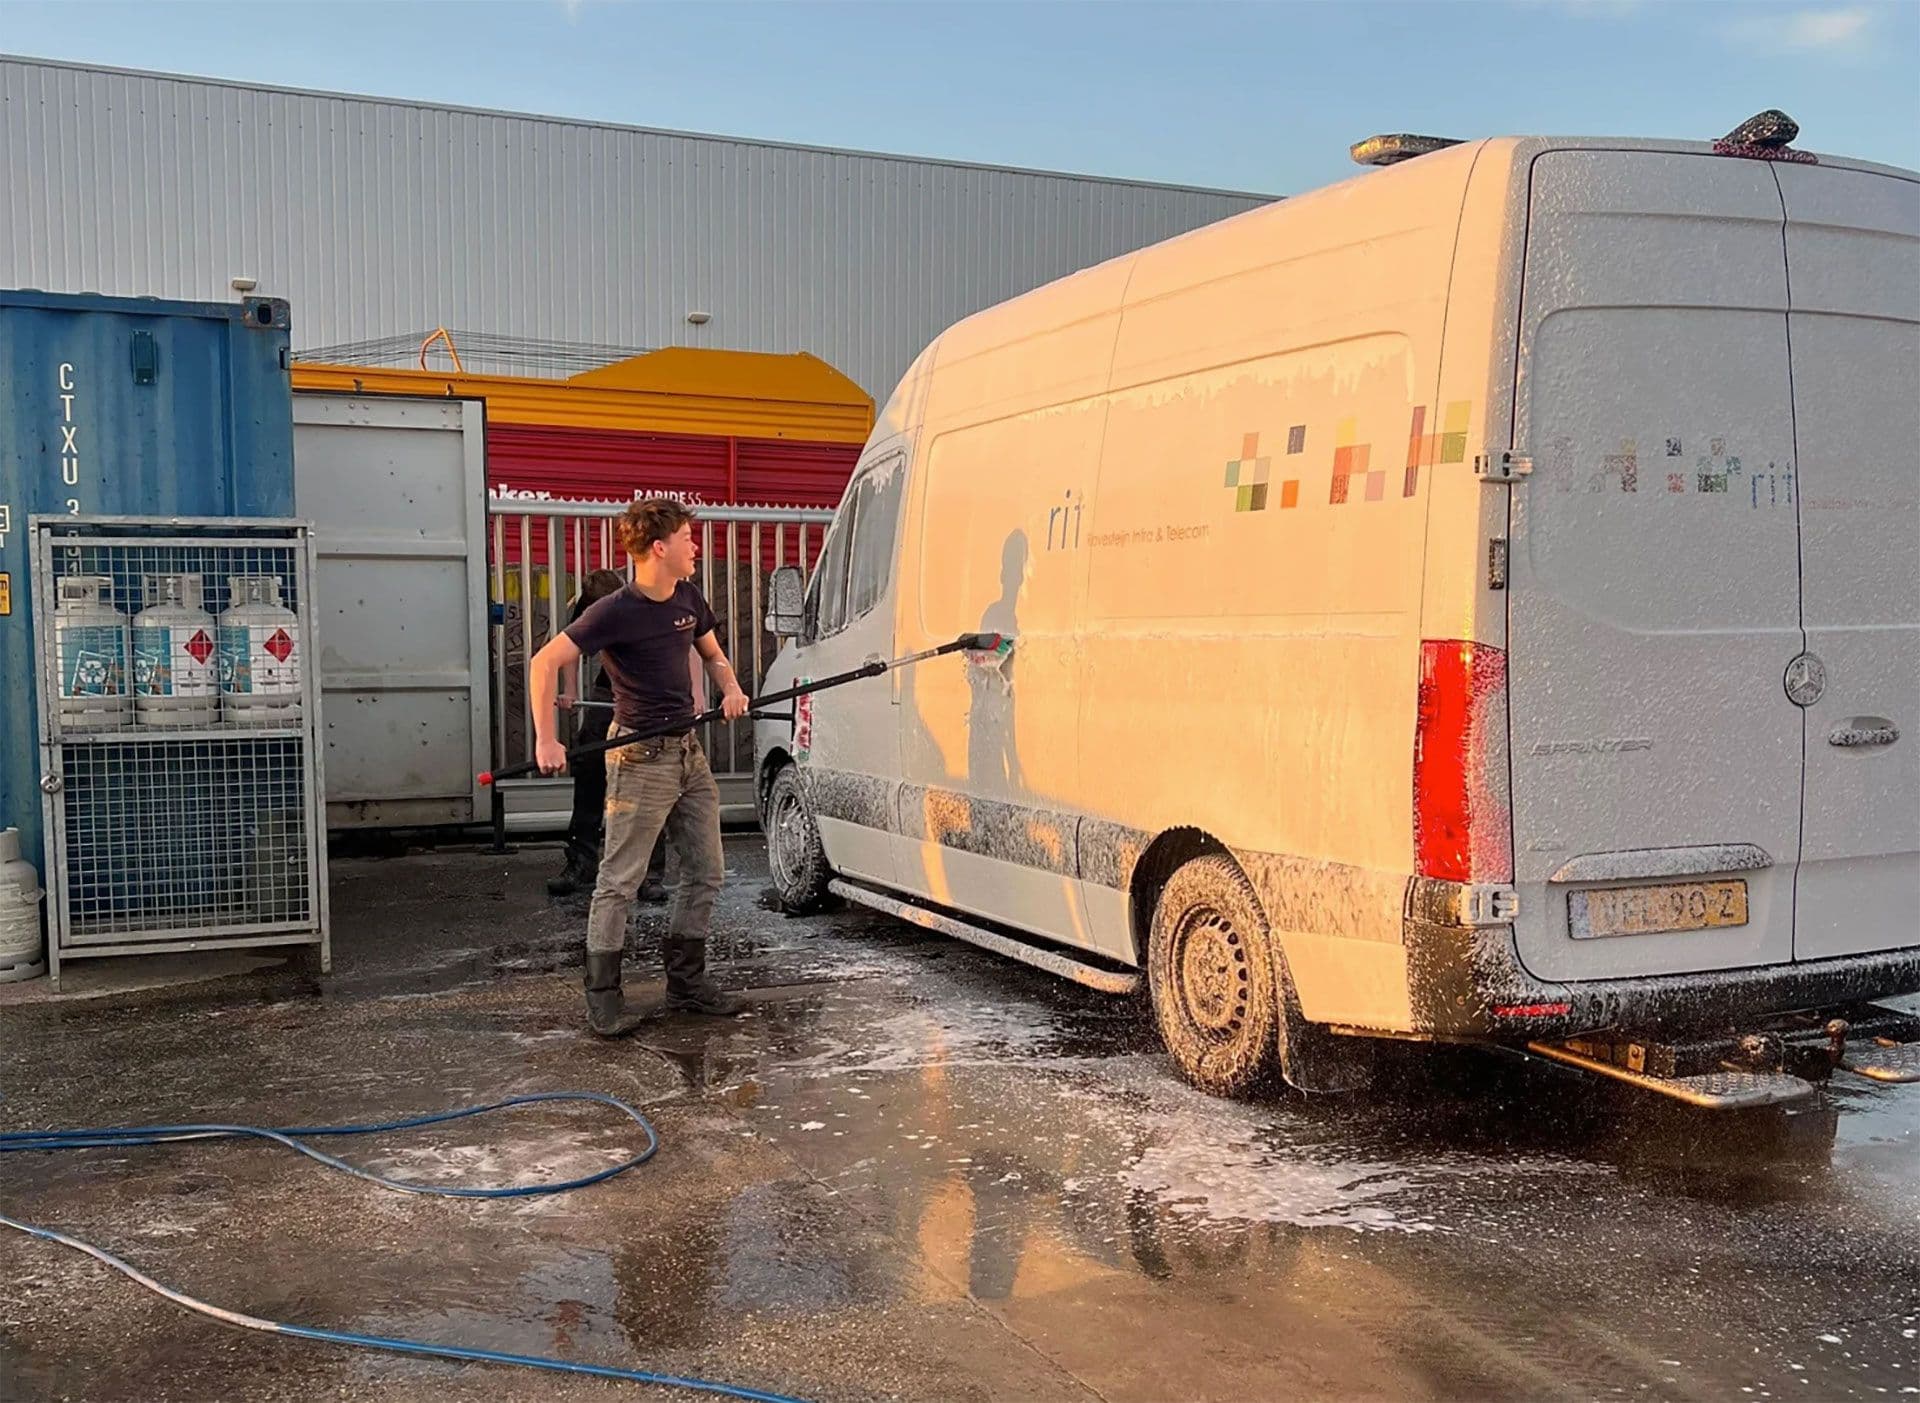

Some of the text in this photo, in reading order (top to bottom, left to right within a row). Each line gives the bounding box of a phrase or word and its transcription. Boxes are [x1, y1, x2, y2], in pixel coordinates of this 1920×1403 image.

[59, 362, 79, 485] CTXU
[1155, 527, 1163, 542] &
[1166, 524, 1210, 541] Telecom
